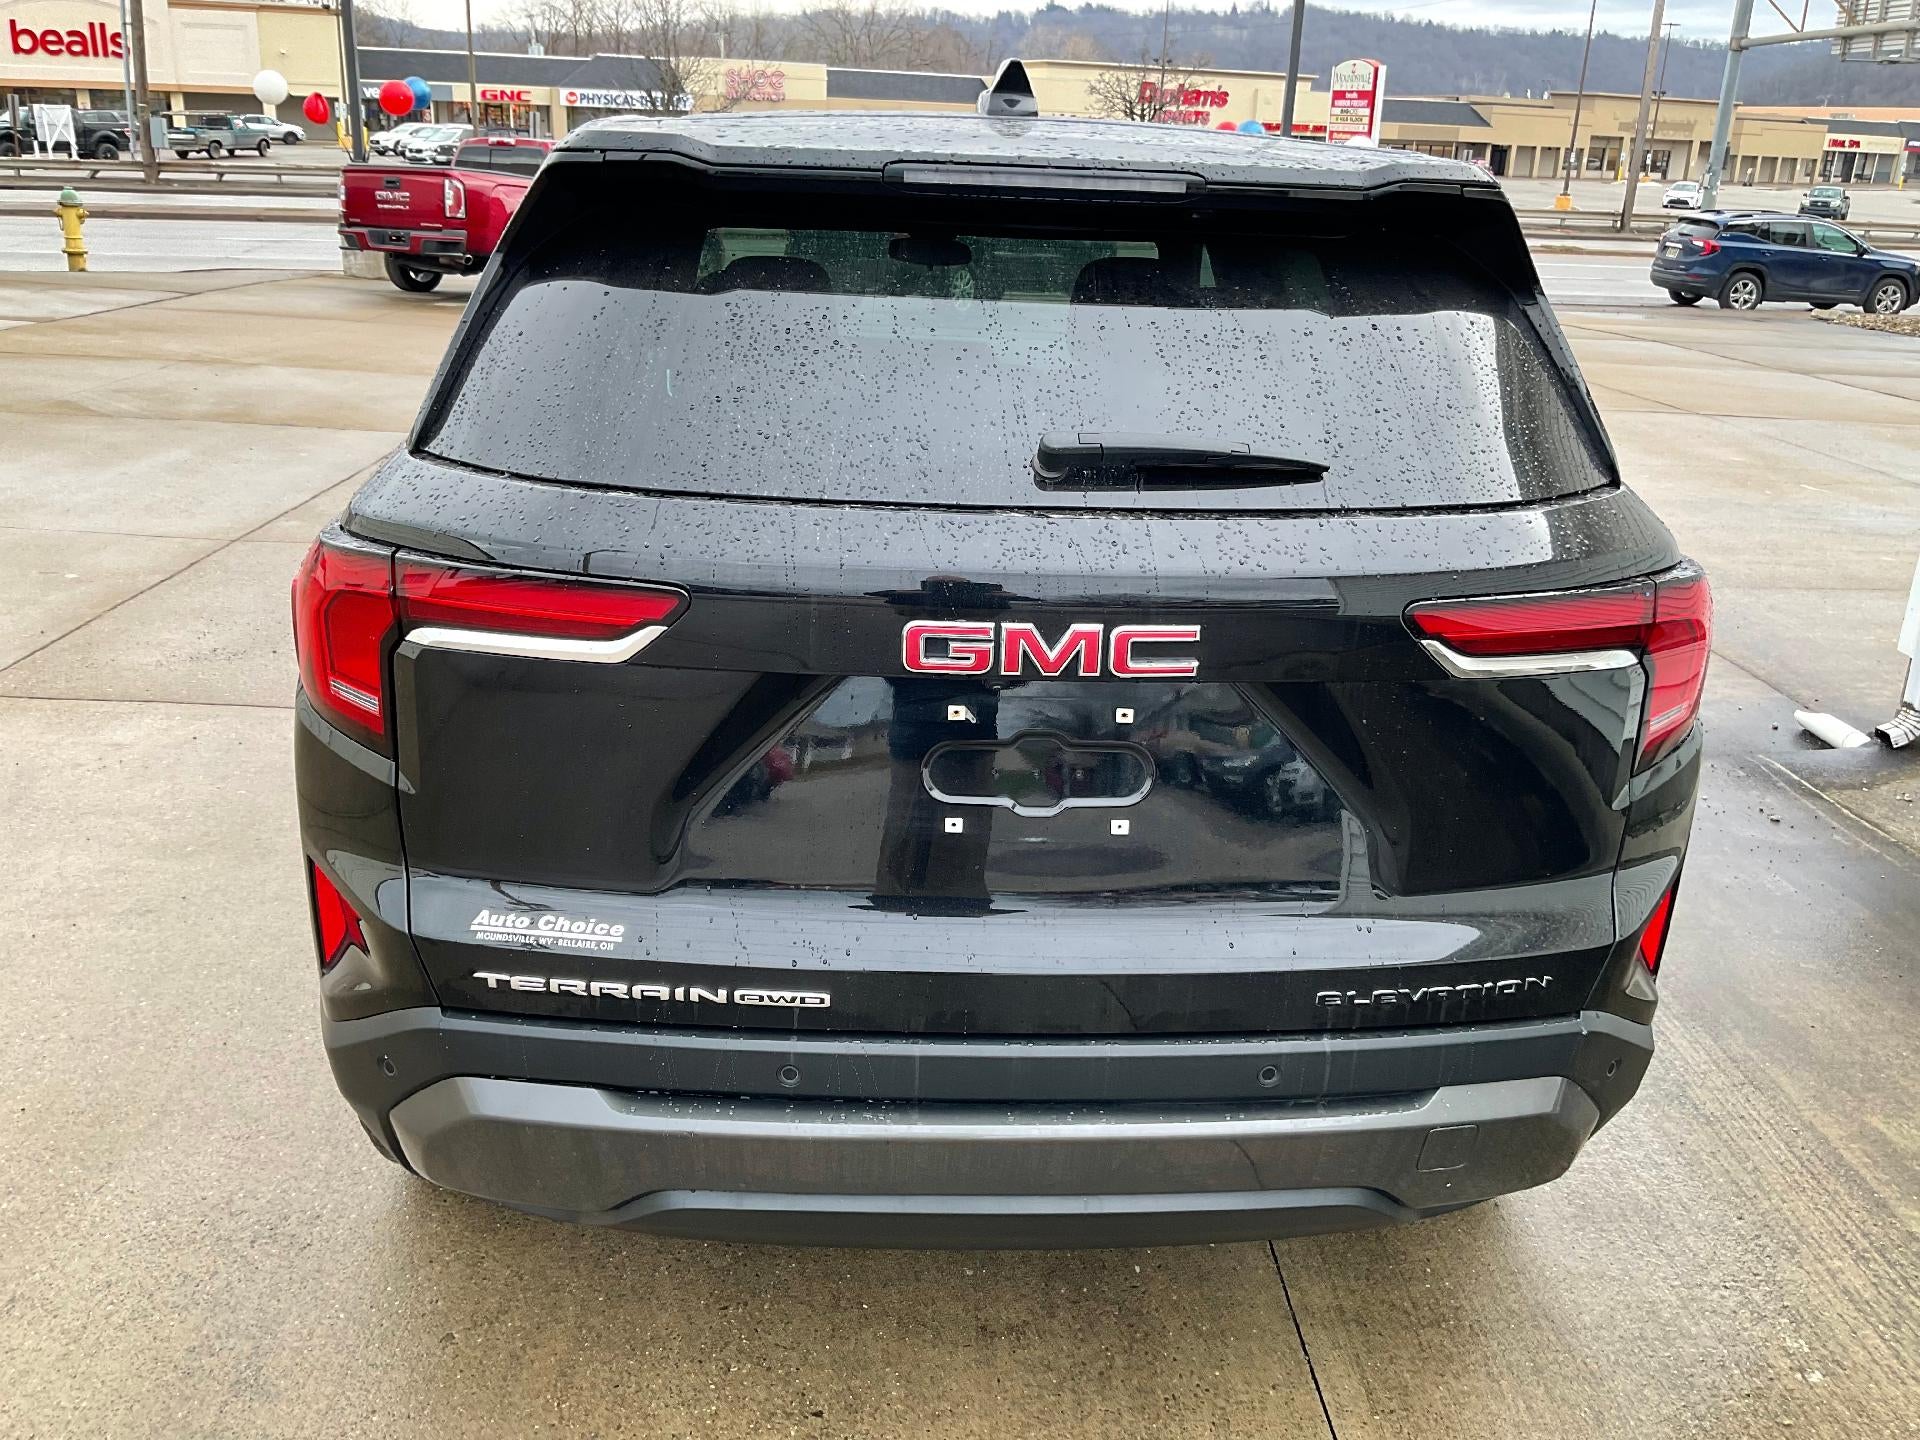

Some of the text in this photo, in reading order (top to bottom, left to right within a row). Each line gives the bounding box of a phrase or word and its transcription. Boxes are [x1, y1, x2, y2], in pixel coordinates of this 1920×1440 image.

[9, 18, 131, 59] bealls
[480, 89, 532, 103] GNC
[579, 92, 636, 106] PHYSICAL
[375, 190, 410, 201] GMC
[901, 619, 1202, 679] GMC
[471, 909, 625, 937] Auto Choice
[475, 931, 537, 945] MOUNDSVILLE,
[557, 939, 599, 950] BELLAIRE,
[600, 942, 614, 951] OH
[473, 971, 830, 1008] TERRAIN AWD
[1315, 975, 1553, 1006] ELEVATION
